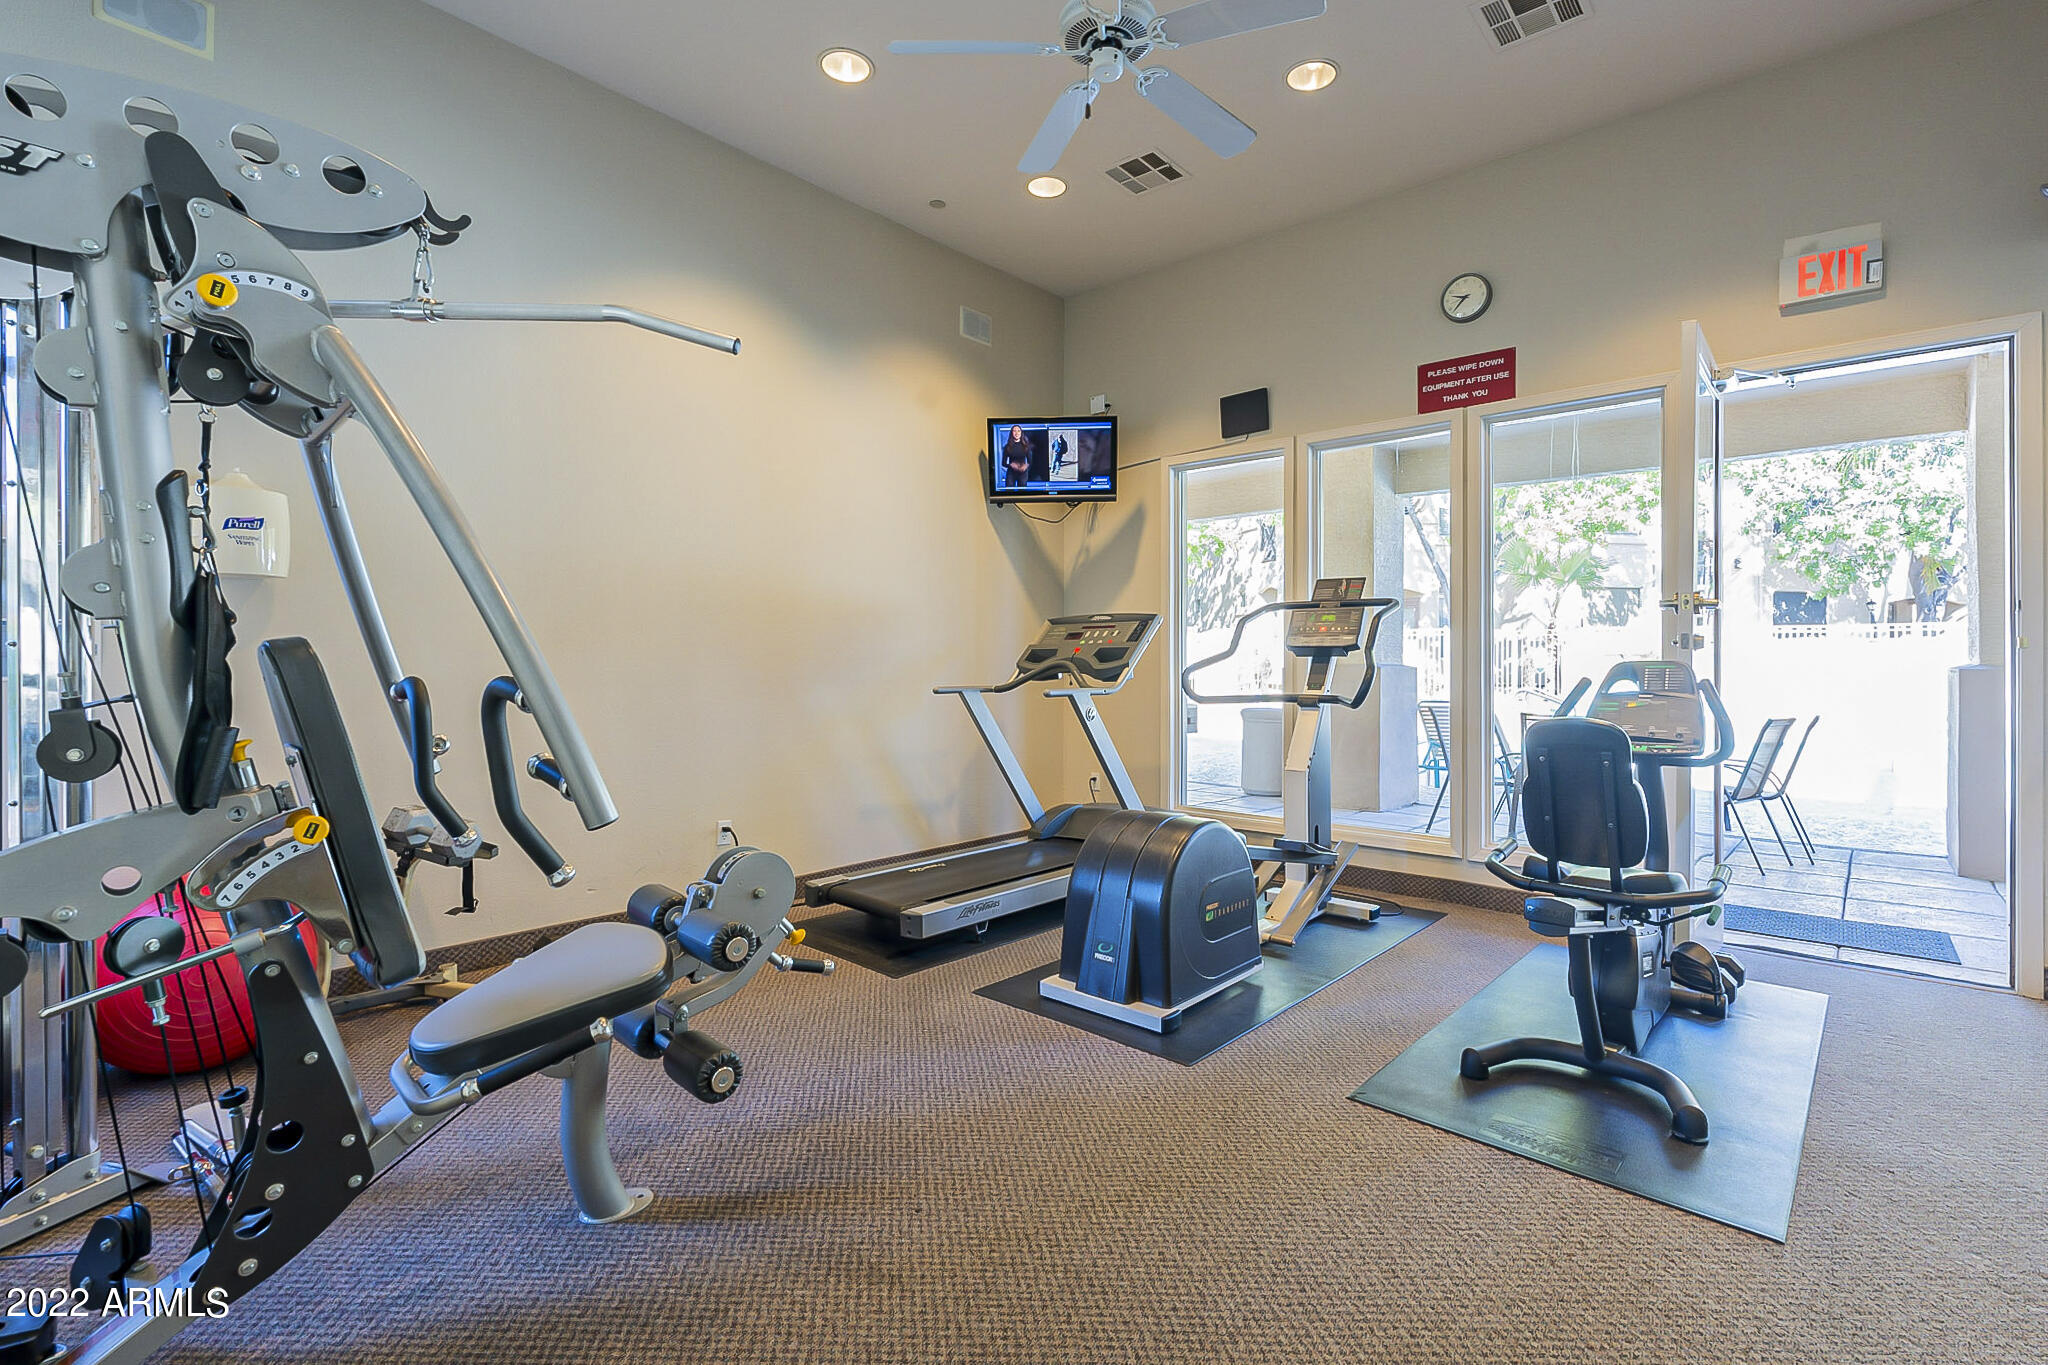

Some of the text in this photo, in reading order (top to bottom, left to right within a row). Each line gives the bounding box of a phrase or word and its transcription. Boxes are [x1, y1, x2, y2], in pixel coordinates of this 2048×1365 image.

[1797, 244, 1868, 298] EXIT
[174, 275, 309, 308] 1 2 5 6 7 8 9
[1427, 358, 1504, 378] PLEASE WIPE DOWN
[1422, 371, 1510, 392] EQUIPMENT AFTER USE
[1442, 389, 1488, 403] THANK YOU
[228, 519, 260, 528] Purell
[221, 844, 300, 902] 7 6 5 4 3 2
